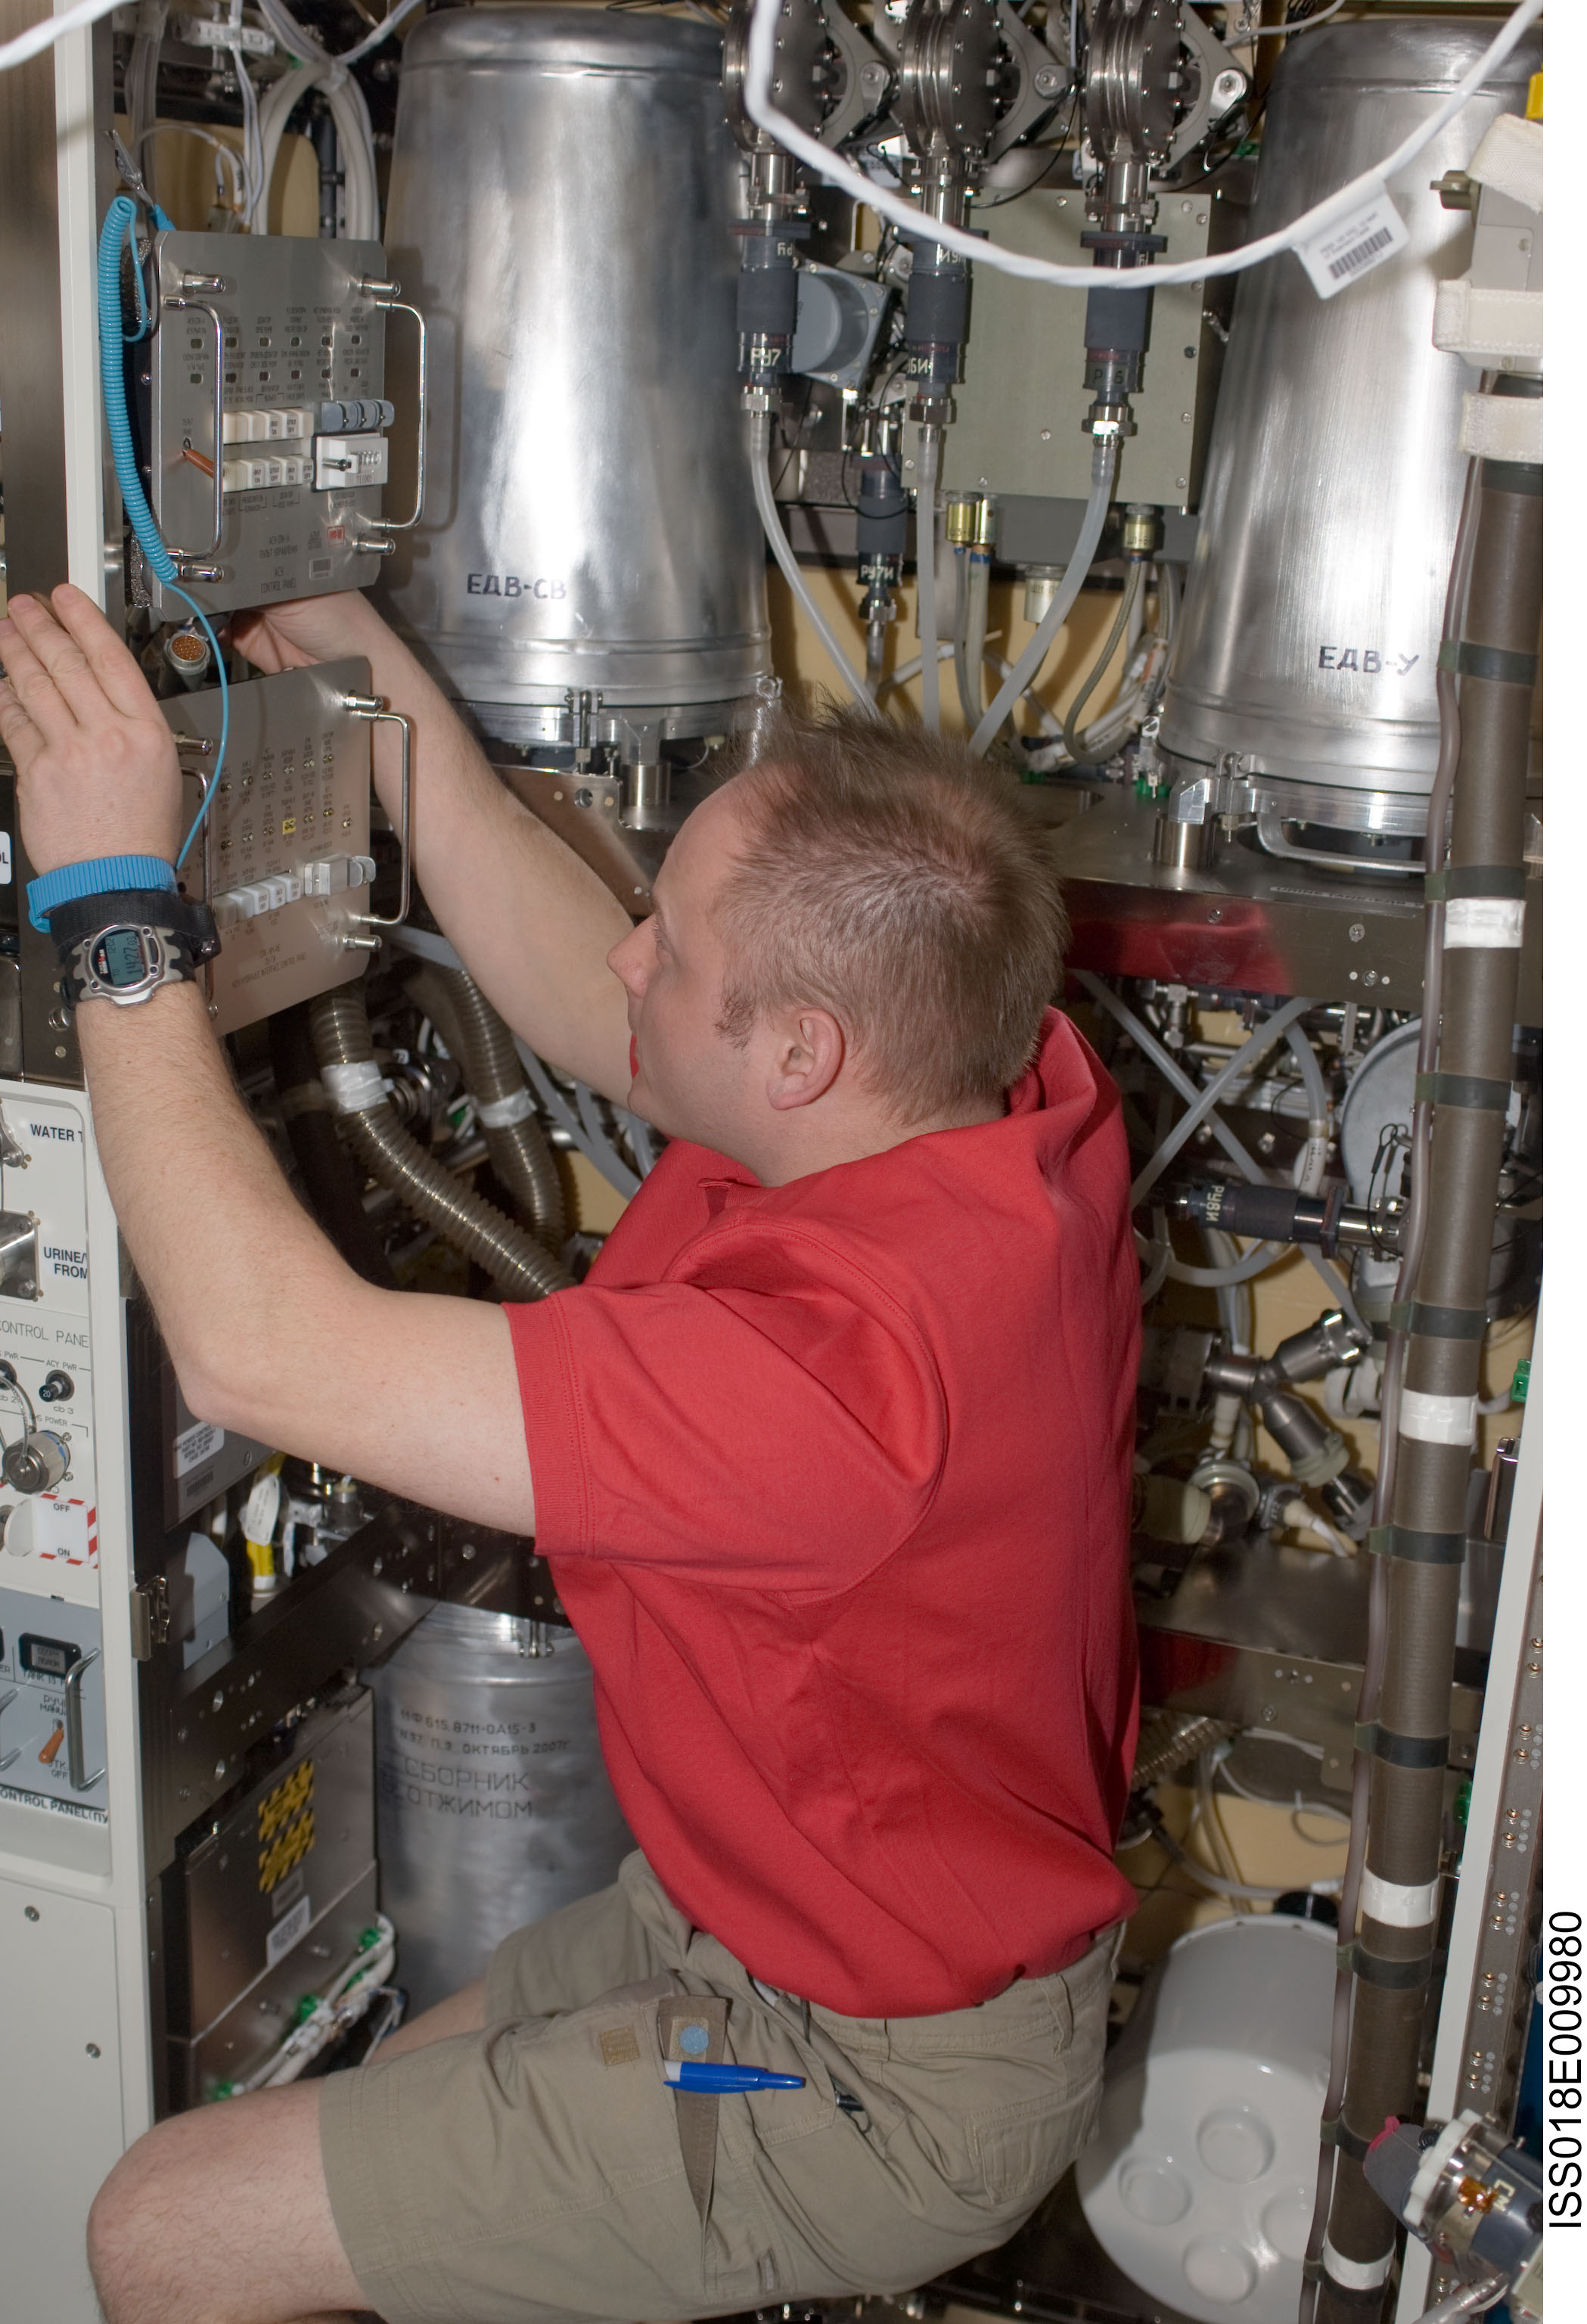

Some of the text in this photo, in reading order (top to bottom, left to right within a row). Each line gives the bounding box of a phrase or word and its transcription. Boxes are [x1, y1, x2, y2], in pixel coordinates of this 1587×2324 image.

[861, 564, 893, 580] РУ7И
[467, 573, 567, 600] ЕДВ-СВ
[1318, 645, 1420, 676] ЕДВ-У
[30, 1123, 75, 1142] WATER
[43, 1246, 88, 1264] URINE/
[4, 1350, 19, 1360] PWR
[63, 1362, 78, 1372] PWR
[42, 1390, 51, 1398] 20
[45, 1415, 68, 1427] POWER
[53, 1502, 70, 1513] OFF
[57, 1547, 70, 1558] ON
[462, 1743, 529, 1756] ОКТЯБРЬ
[51, 1769, 68, 1780] OFF
[403, 1757, 529, 1792] СБОРНИК
[406, 1785, 533, 1819] ОТЖИМОМ
